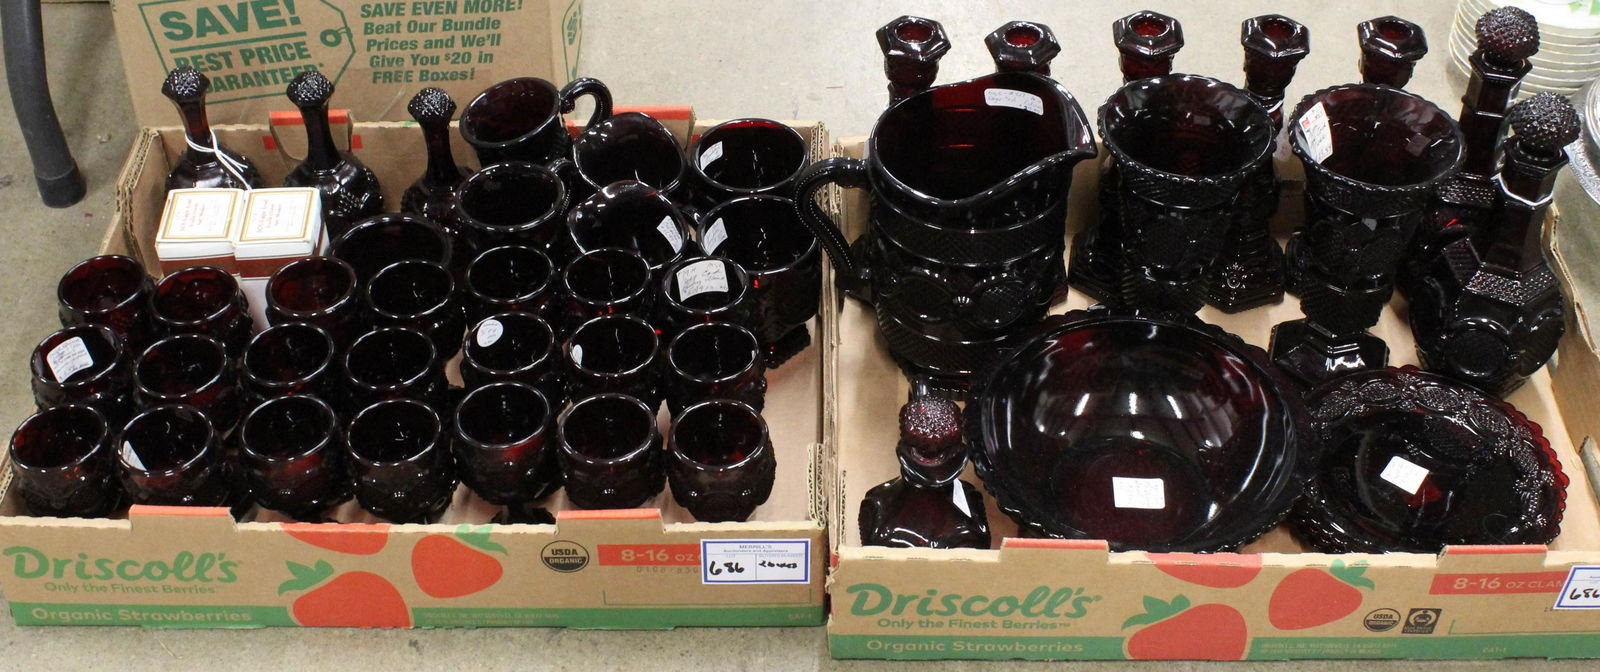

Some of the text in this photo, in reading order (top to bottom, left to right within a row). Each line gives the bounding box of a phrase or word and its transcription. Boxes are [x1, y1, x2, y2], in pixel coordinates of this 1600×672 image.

[361, 0, 522, 18] SAVE EVEN MORE!
[160, 0, 301, 41] SAVE!
[364, 17, 501, 35] Beat Our Bundle
[367, 33, 501, 52] Prices and We'll
[239, 41, 312, 66] PRICE
[369, 51, 494, 68] Give You $20 in
[372, 68, 475, 84] FREE Boxes!
[551, 548, 578, 556] USDA
[621, 549, 670, 562] 8-16
[3, 546, 239, 583] Driscoll's
[550, 557, 583, 565] ORGANIC
[709, 560, 745, 575] 686
[44, 582, 79, 593] Only
[83, 583, 107, 592] the
[111, 583, 159, 593] Finest
[1453, 577, 1501, 589] 8-16
[846, 582, 1092, 618] Driscoll's
[1570, 587, 1600, 600] 686
[32, 607, 252, 622] Organic Strawberries
[877, 618, 913, 629] Only
[918, 619, 944, 628] the
[948, 619, 998, 629] Finest
[867, 639, 1085, 653] Organic Strawberries
